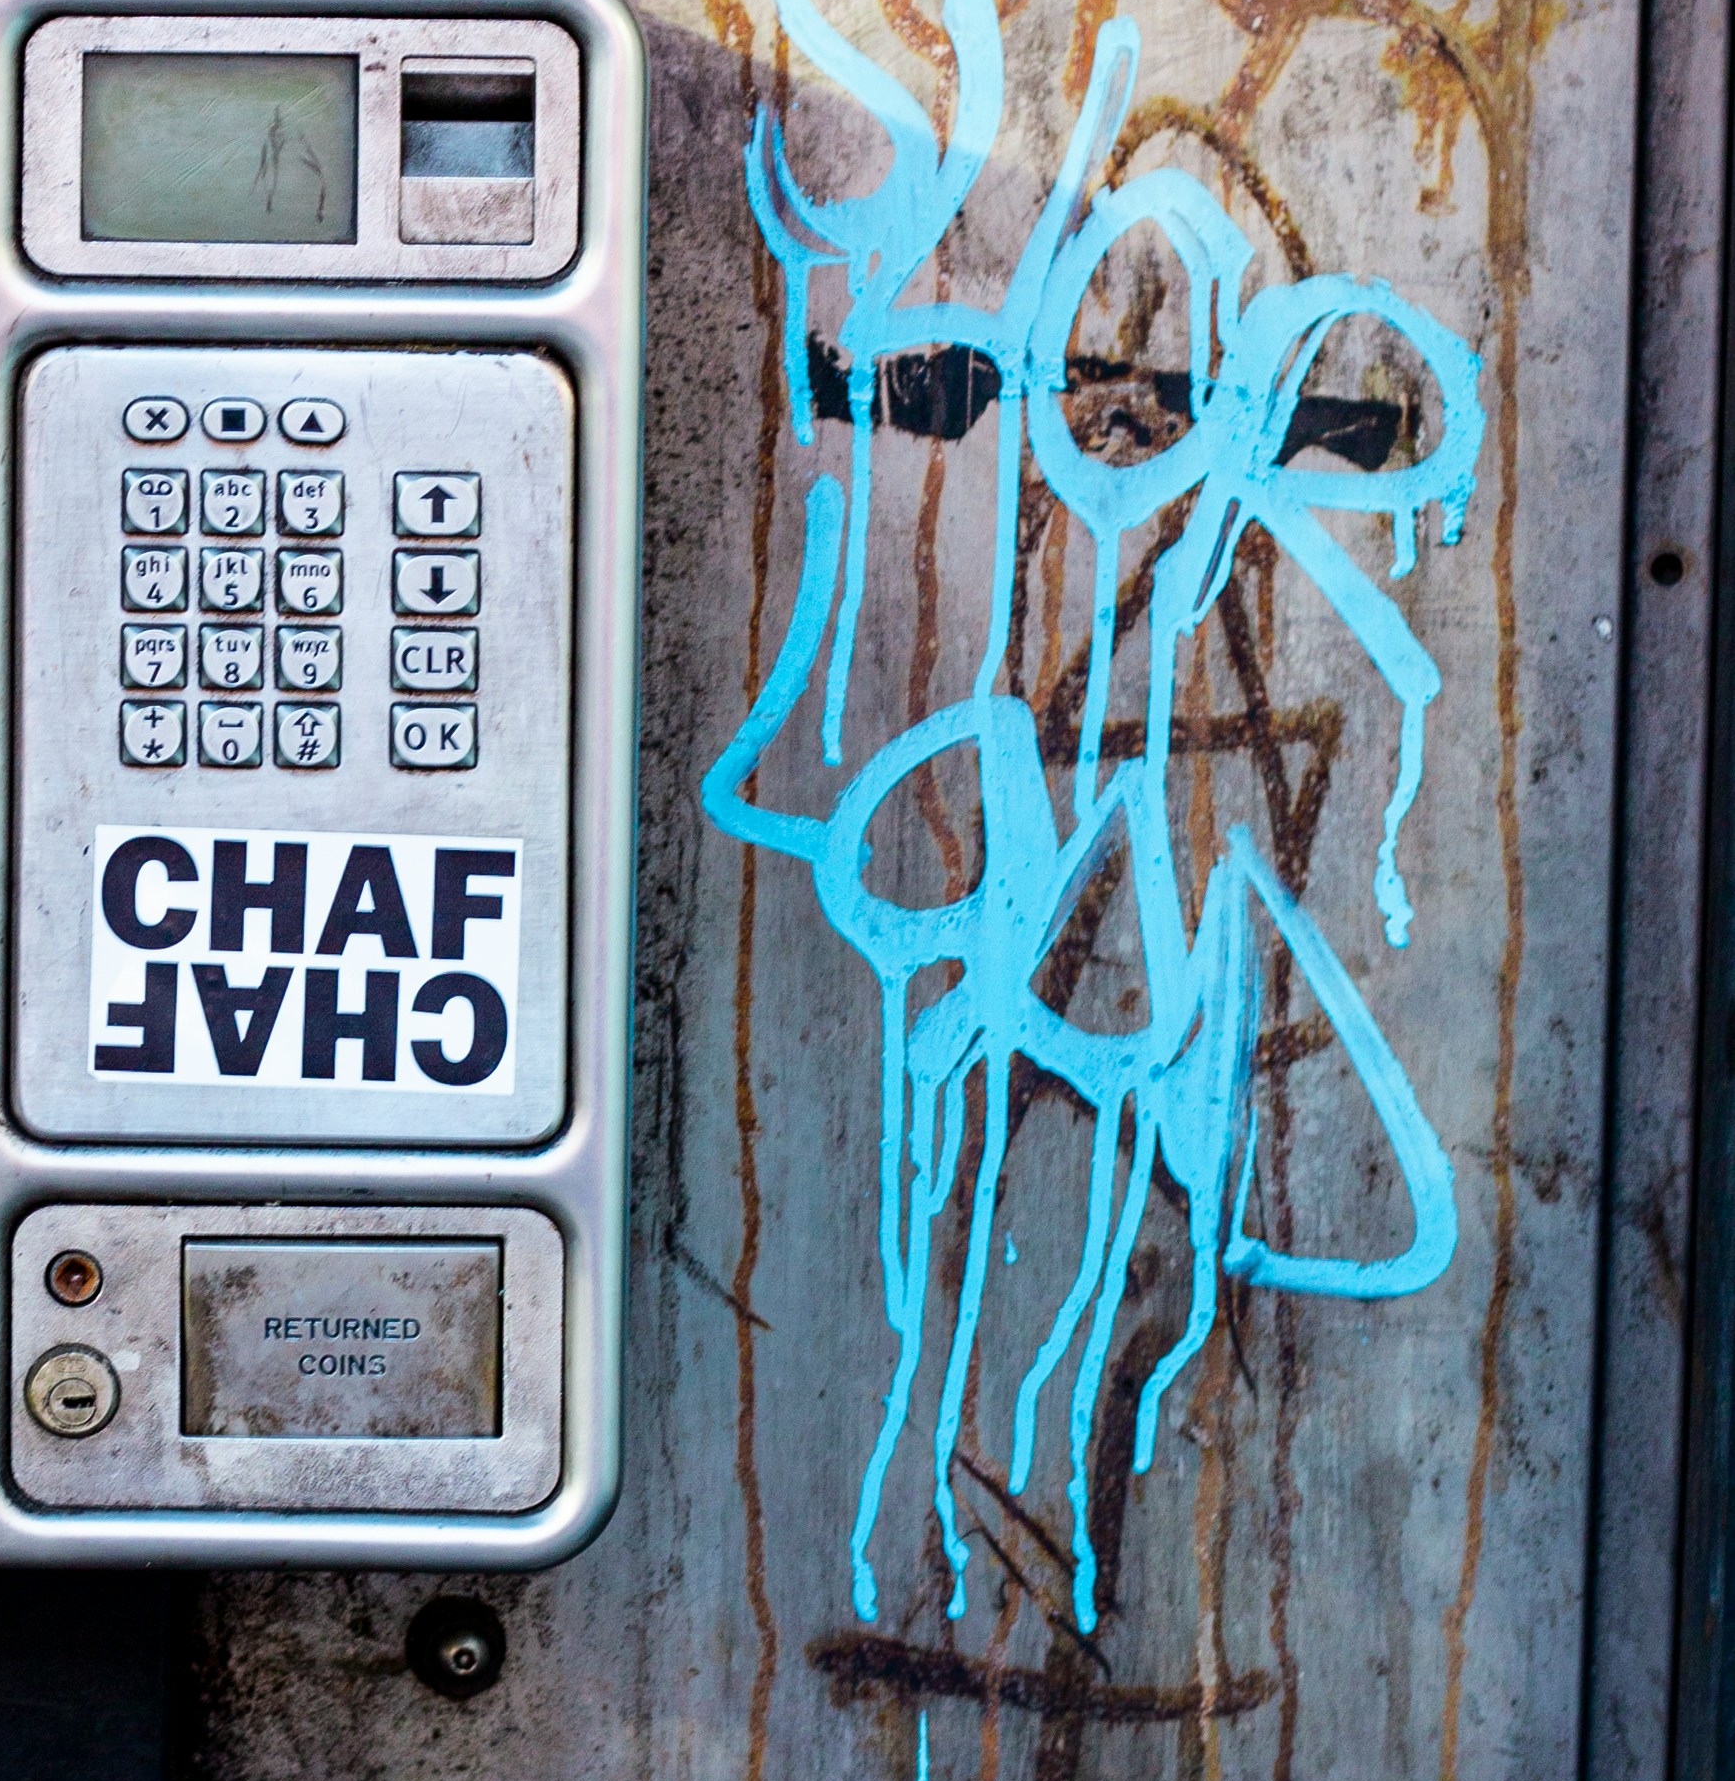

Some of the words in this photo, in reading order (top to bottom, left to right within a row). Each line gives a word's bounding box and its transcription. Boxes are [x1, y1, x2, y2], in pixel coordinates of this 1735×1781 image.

[213, 480, 252, 498] abc
[292, 481, 328, 499] def
[150, 508, 163, 529] 1
[224, 507, 240, 529] 2
[305, 507, 319, 530] 3
[135, 556, 171, 577] ghi
[214, 556, 249, 578] jkl
[289, 562, 331, 578] mno
[146, 583, 164, 604] 4
[223, 583, 240, 606] 5
[303, 586, 318, 609] 6
[134, 637, 176, 656] pqrs
[214, 636, 252, 654] tuv
[291, 638, 330, 656] wxyz
[400, 645, 466, 676] CLR
[147, 663, 163, 687] 7
[224, 663, 241, 684] 8
[302, 663, 317, 685] 9
[222, 739, 240, 762] 0
[101, 834, 517, 961] CHAF
[263, 1316, 422, 1343] RETURNED
[297, 1353, 387, 1378] COINS
